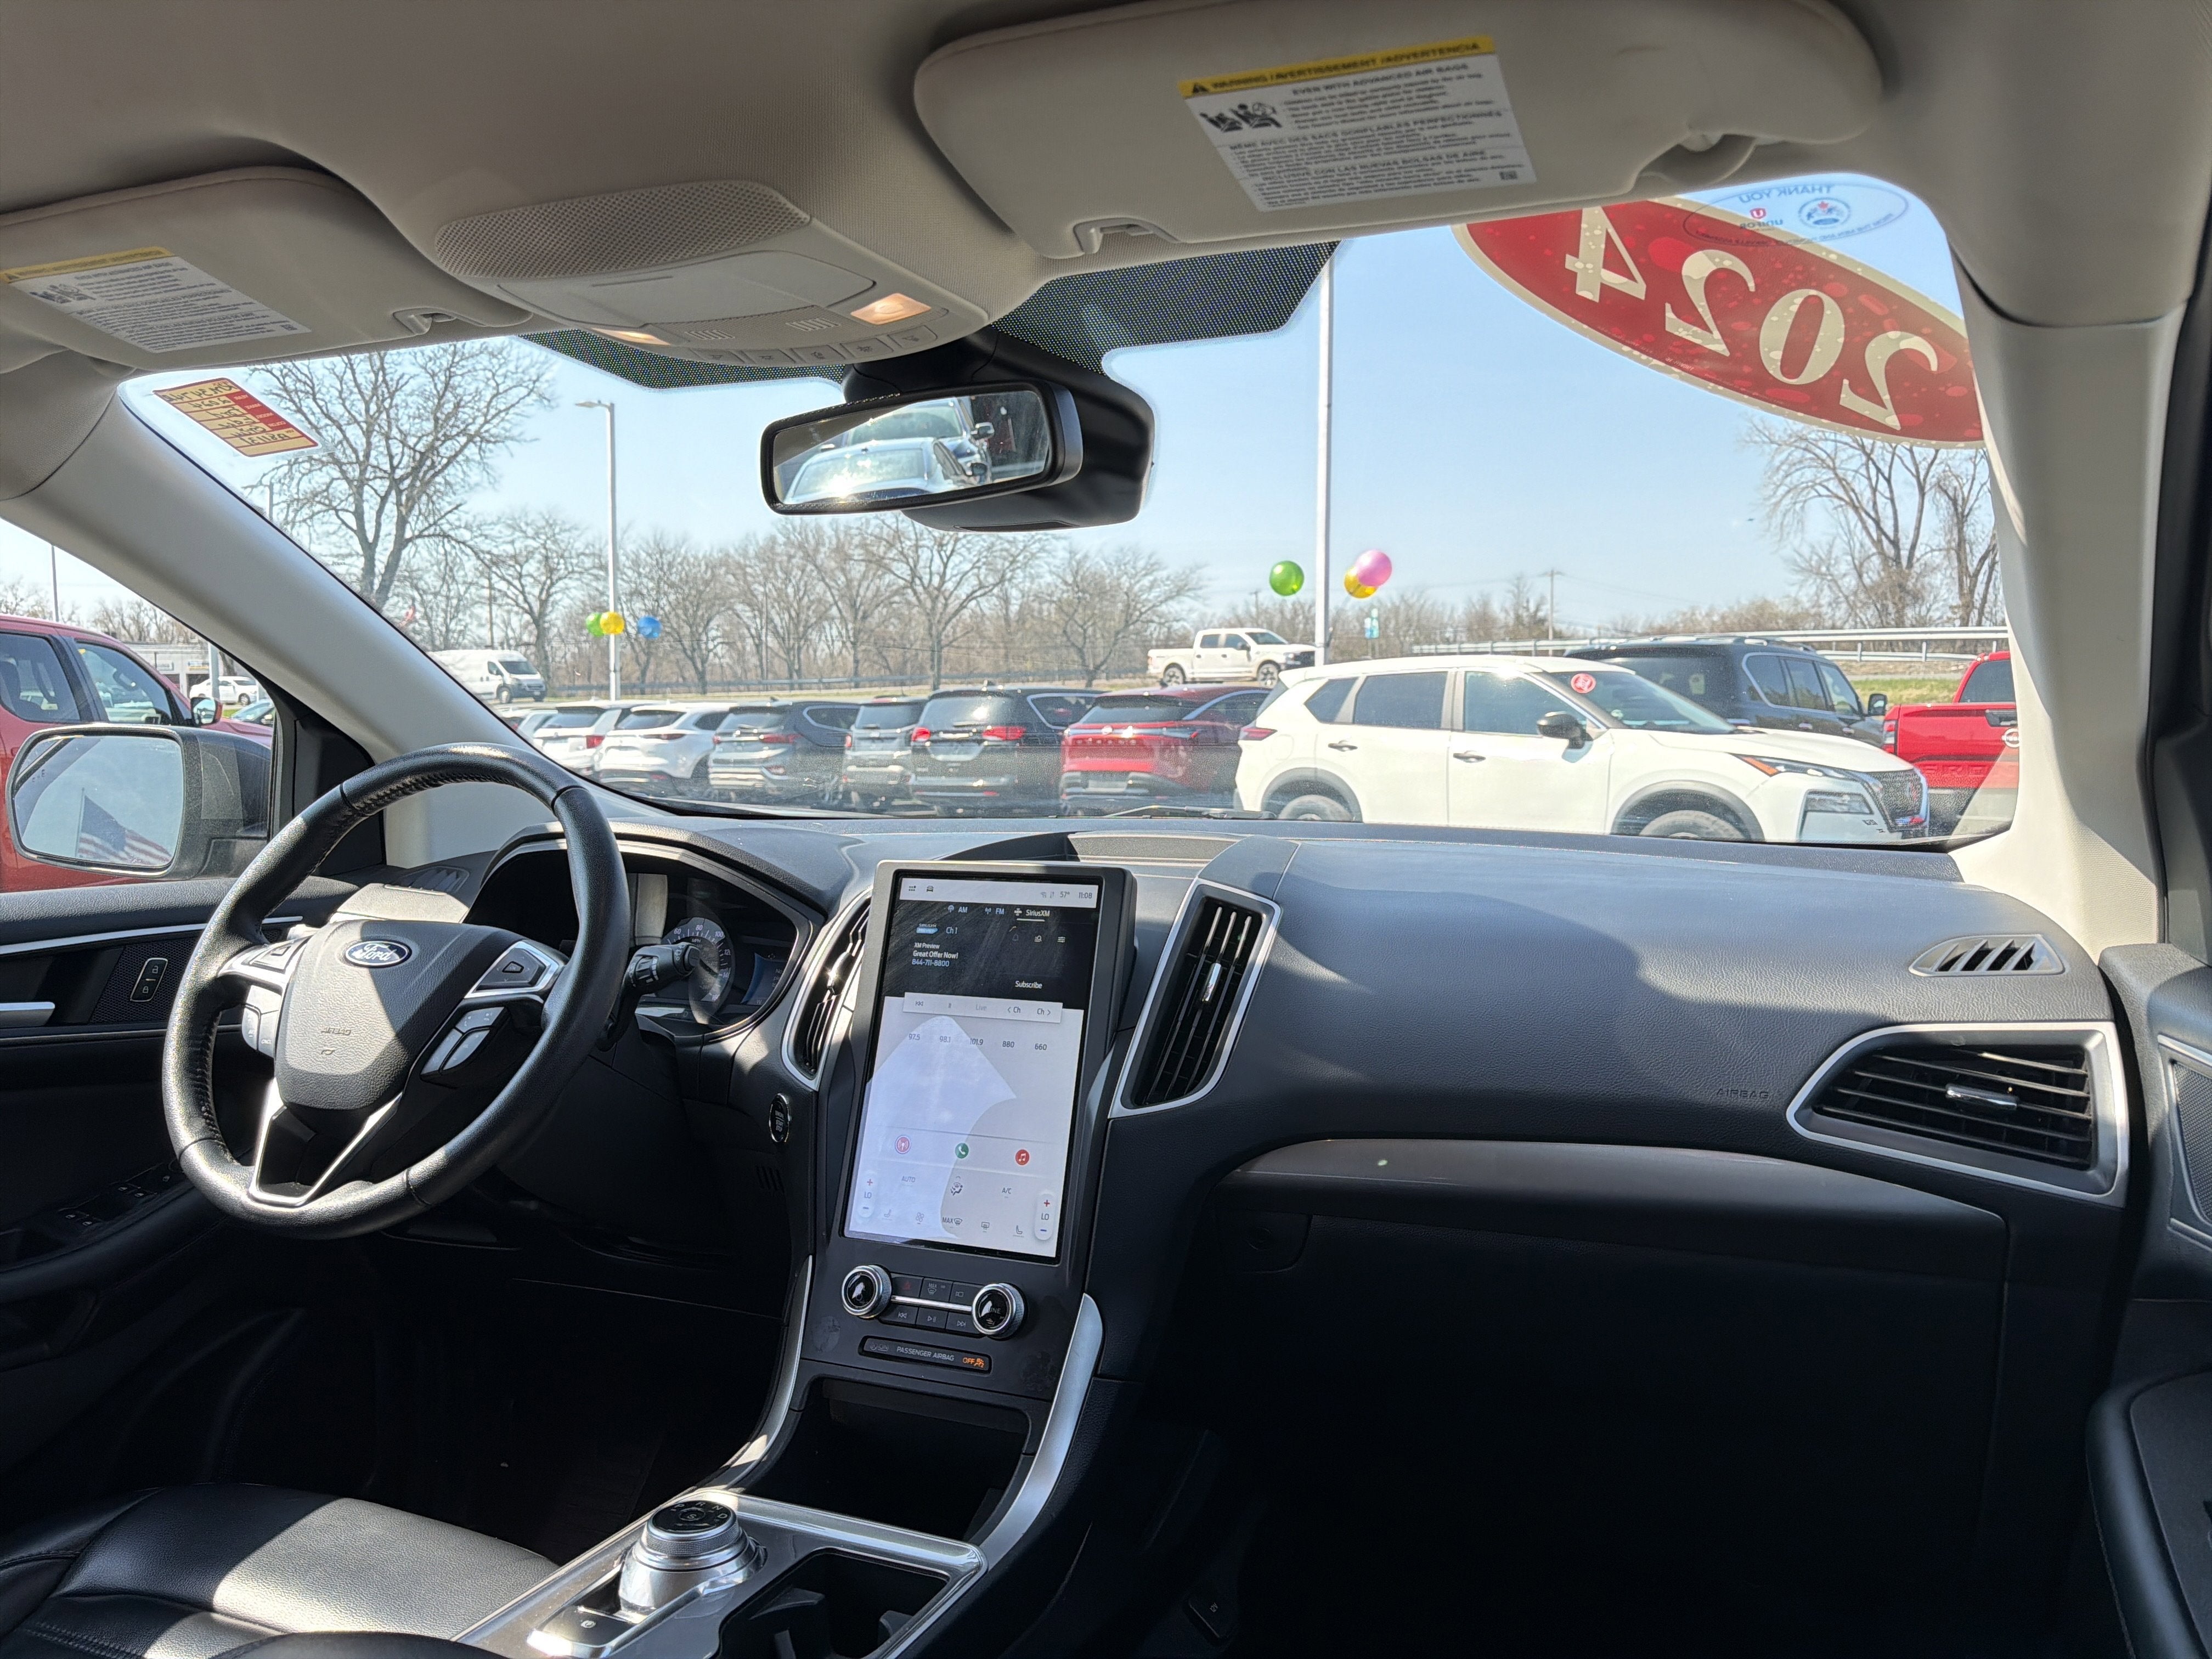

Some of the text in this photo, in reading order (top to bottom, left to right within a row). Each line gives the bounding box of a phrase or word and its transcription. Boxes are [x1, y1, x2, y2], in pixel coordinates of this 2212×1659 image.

[1026, 909, 1050, 917] SiriusXM
[352, 943, 397, 961] Ford
[912, 958, 950, 967] 844-711-8800
[1015, 980, 1042, 989] Subscribe
[1716, 1088, 1770, 1099] AIRBAG
[901, 1175, 916, 1183] AUTO
[1002, 1186, 1012, 1195] A/C
[942, 1216, 954, 1224] MAX
[1041, 1212, 1049, 1221] LO
[896, 1346, 955, 1362] PASSENGER AIRBAG
[962, 1357, 975, 1365] OFF
